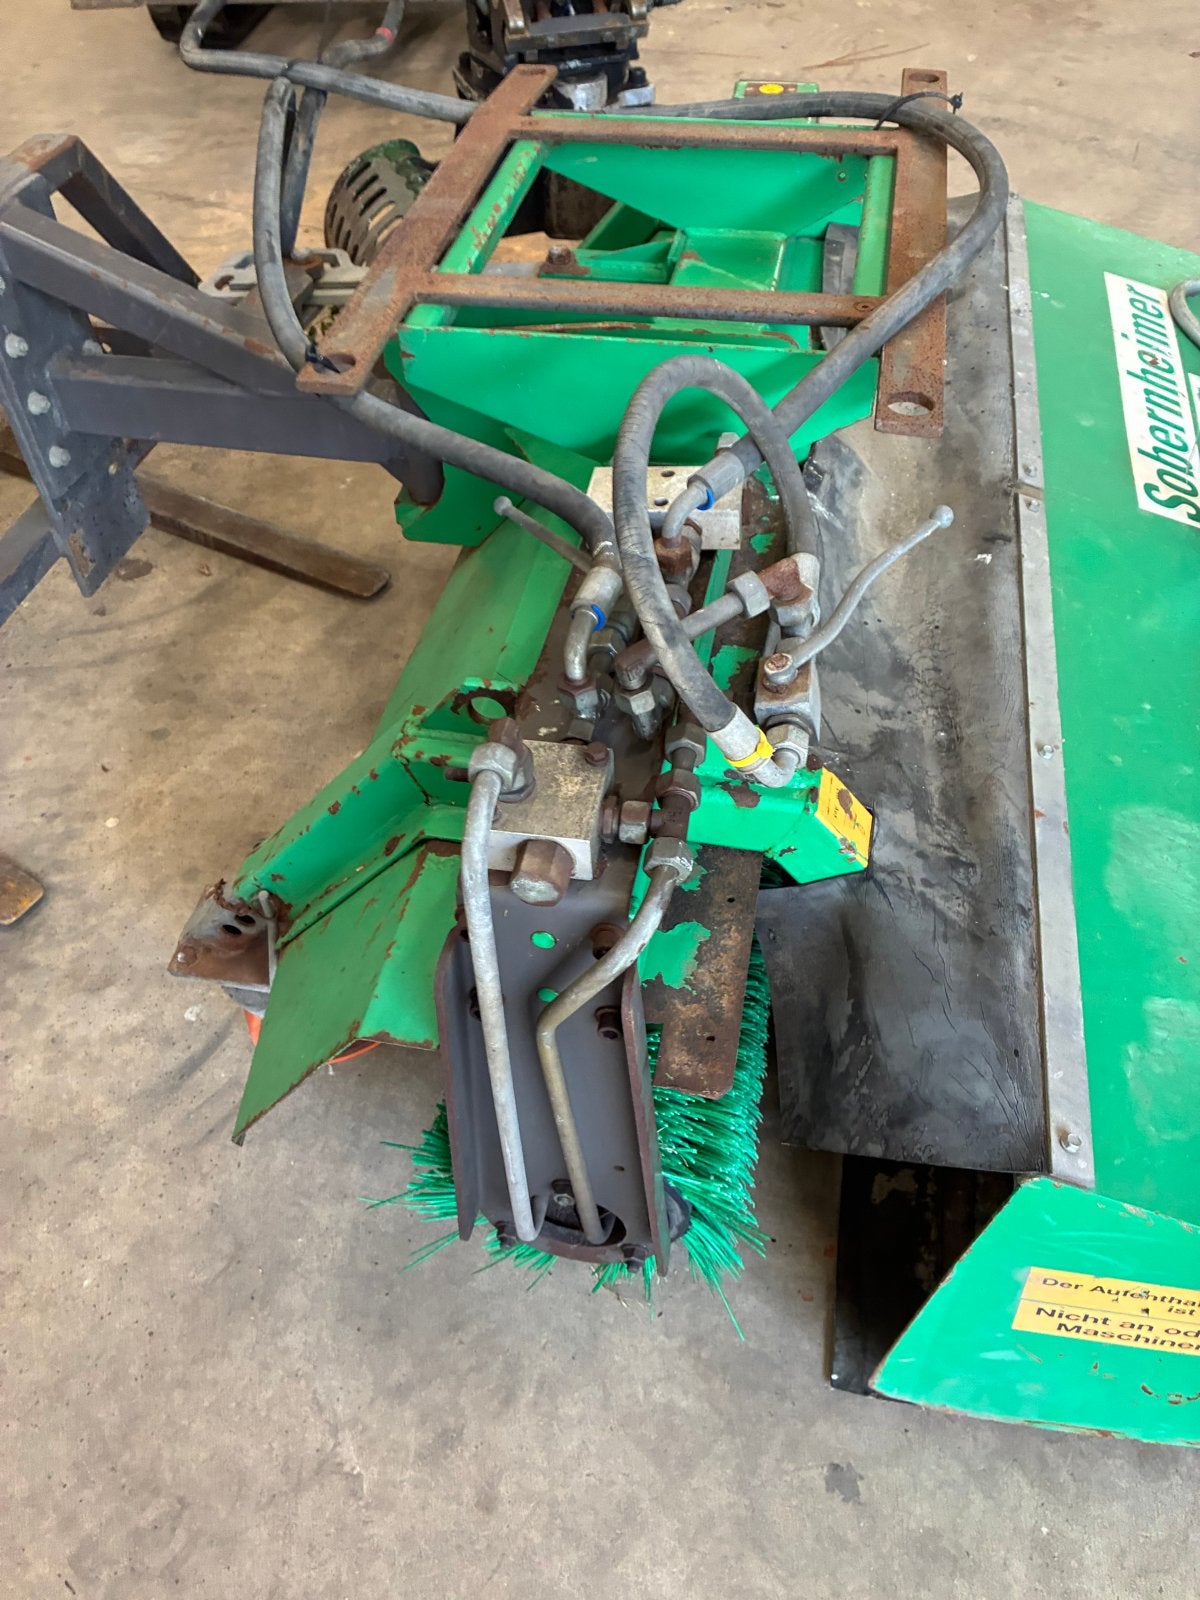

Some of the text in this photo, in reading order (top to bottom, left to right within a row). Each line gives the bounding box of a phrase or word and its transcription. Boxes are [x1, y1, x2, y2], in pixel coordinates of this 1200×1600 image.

[1121, 283, 1200, 522] Sobernheimer
[1042, 1277, 1084, 1290] Der
[1035, 1307, 1112, 1326] Nicht
[1119, 1320, 1154, 1332] an
[1167, 1305, 1196, 1316] ist
